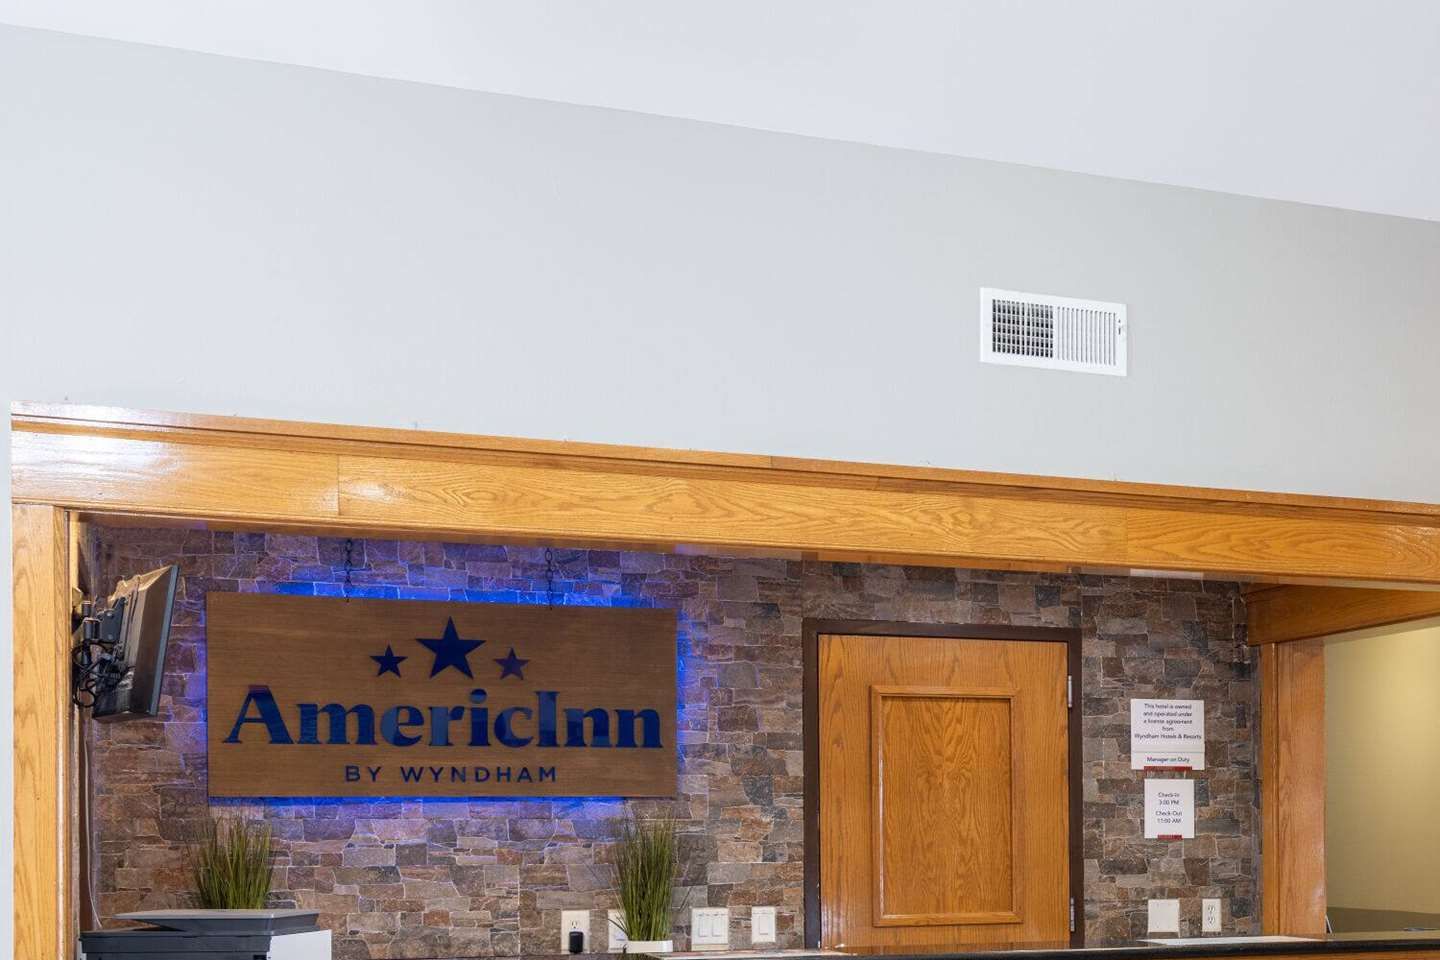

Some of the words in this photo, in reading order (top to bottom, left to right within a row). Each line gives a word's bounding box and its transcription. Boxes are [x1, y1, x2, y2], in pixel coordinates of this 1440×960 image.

[221, 684, 664, 749] AmericInn
[344, 765, 382, 783] BY
[400, 765, 557, 783] WYNDHAM
